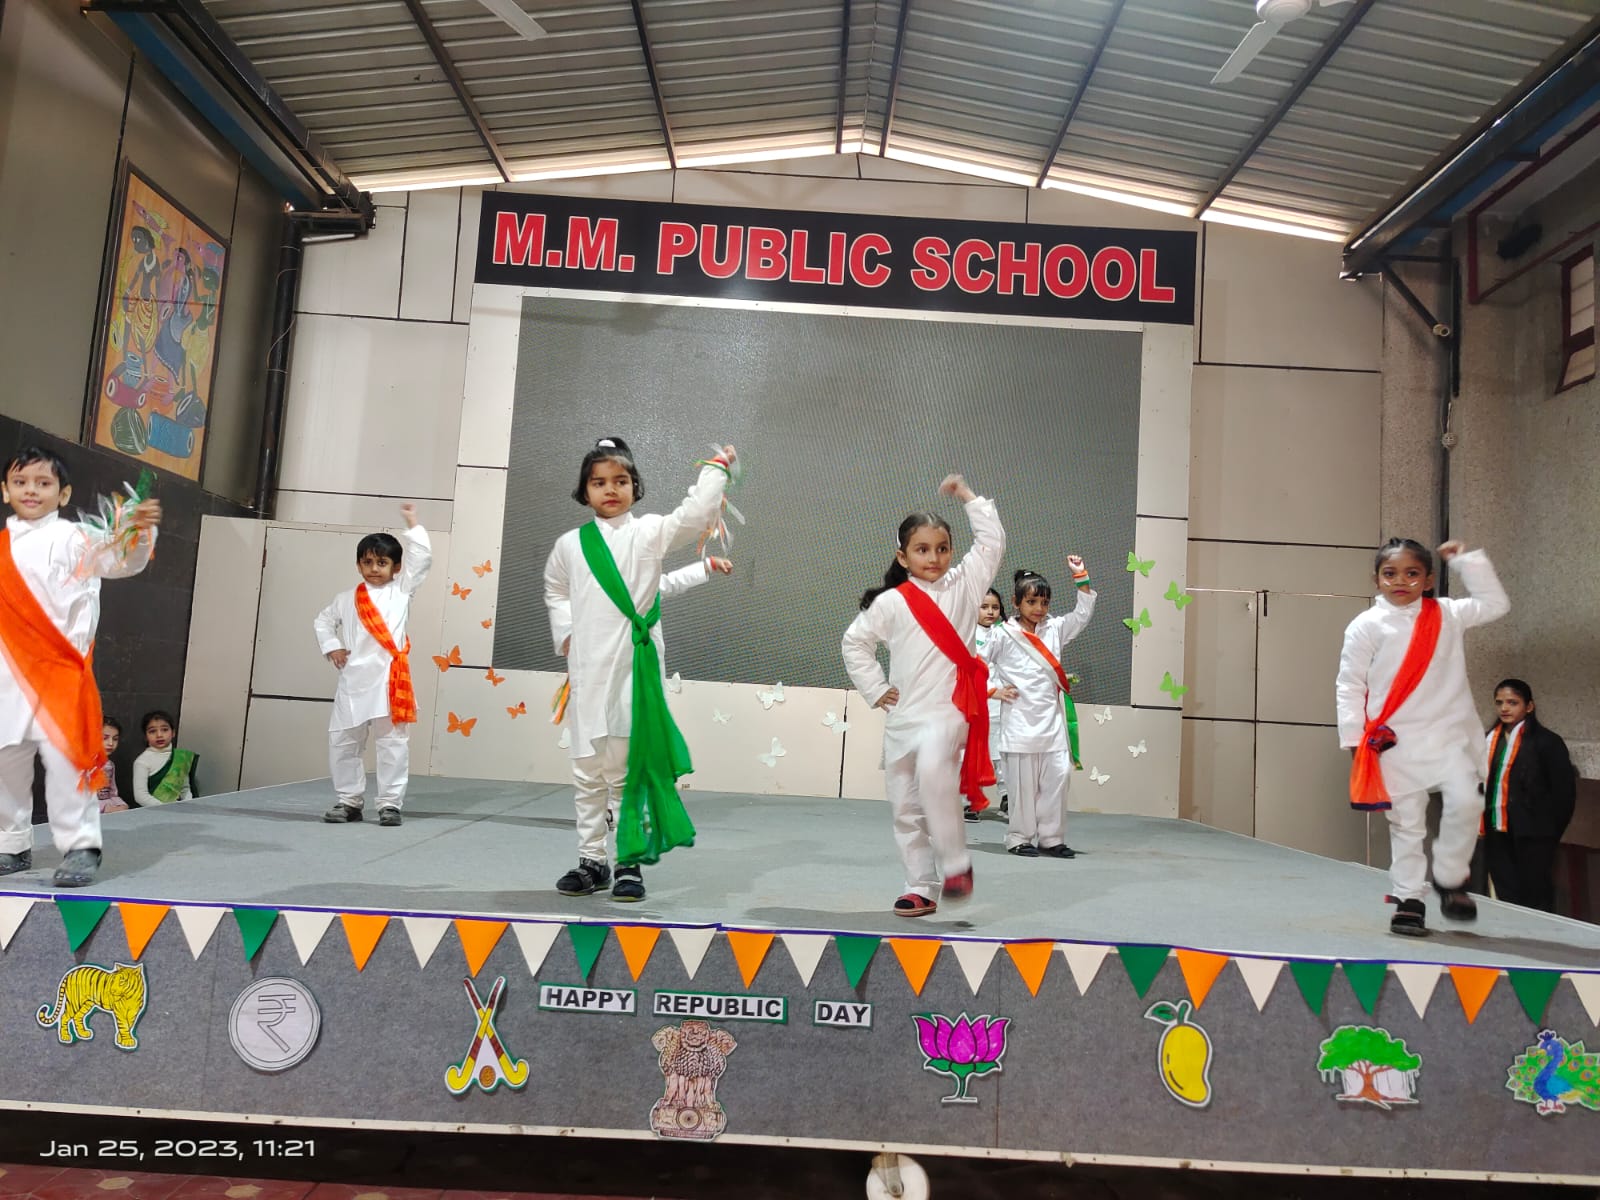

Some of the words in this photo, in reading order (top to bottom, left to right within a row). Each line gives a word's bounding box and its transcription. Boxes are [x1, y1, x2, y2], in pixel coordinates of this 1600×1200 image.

[492, 211, 635, 272] M.M.
[656, 222, 892, 288] PUBLIC
[910, 236, 1176, 304] SCHOOL
[546, 988, 632, 1011] HAPPY
[656, 994, 782, 1018] REPUBLIC
[817, 1003, 869, 1024] DAY
